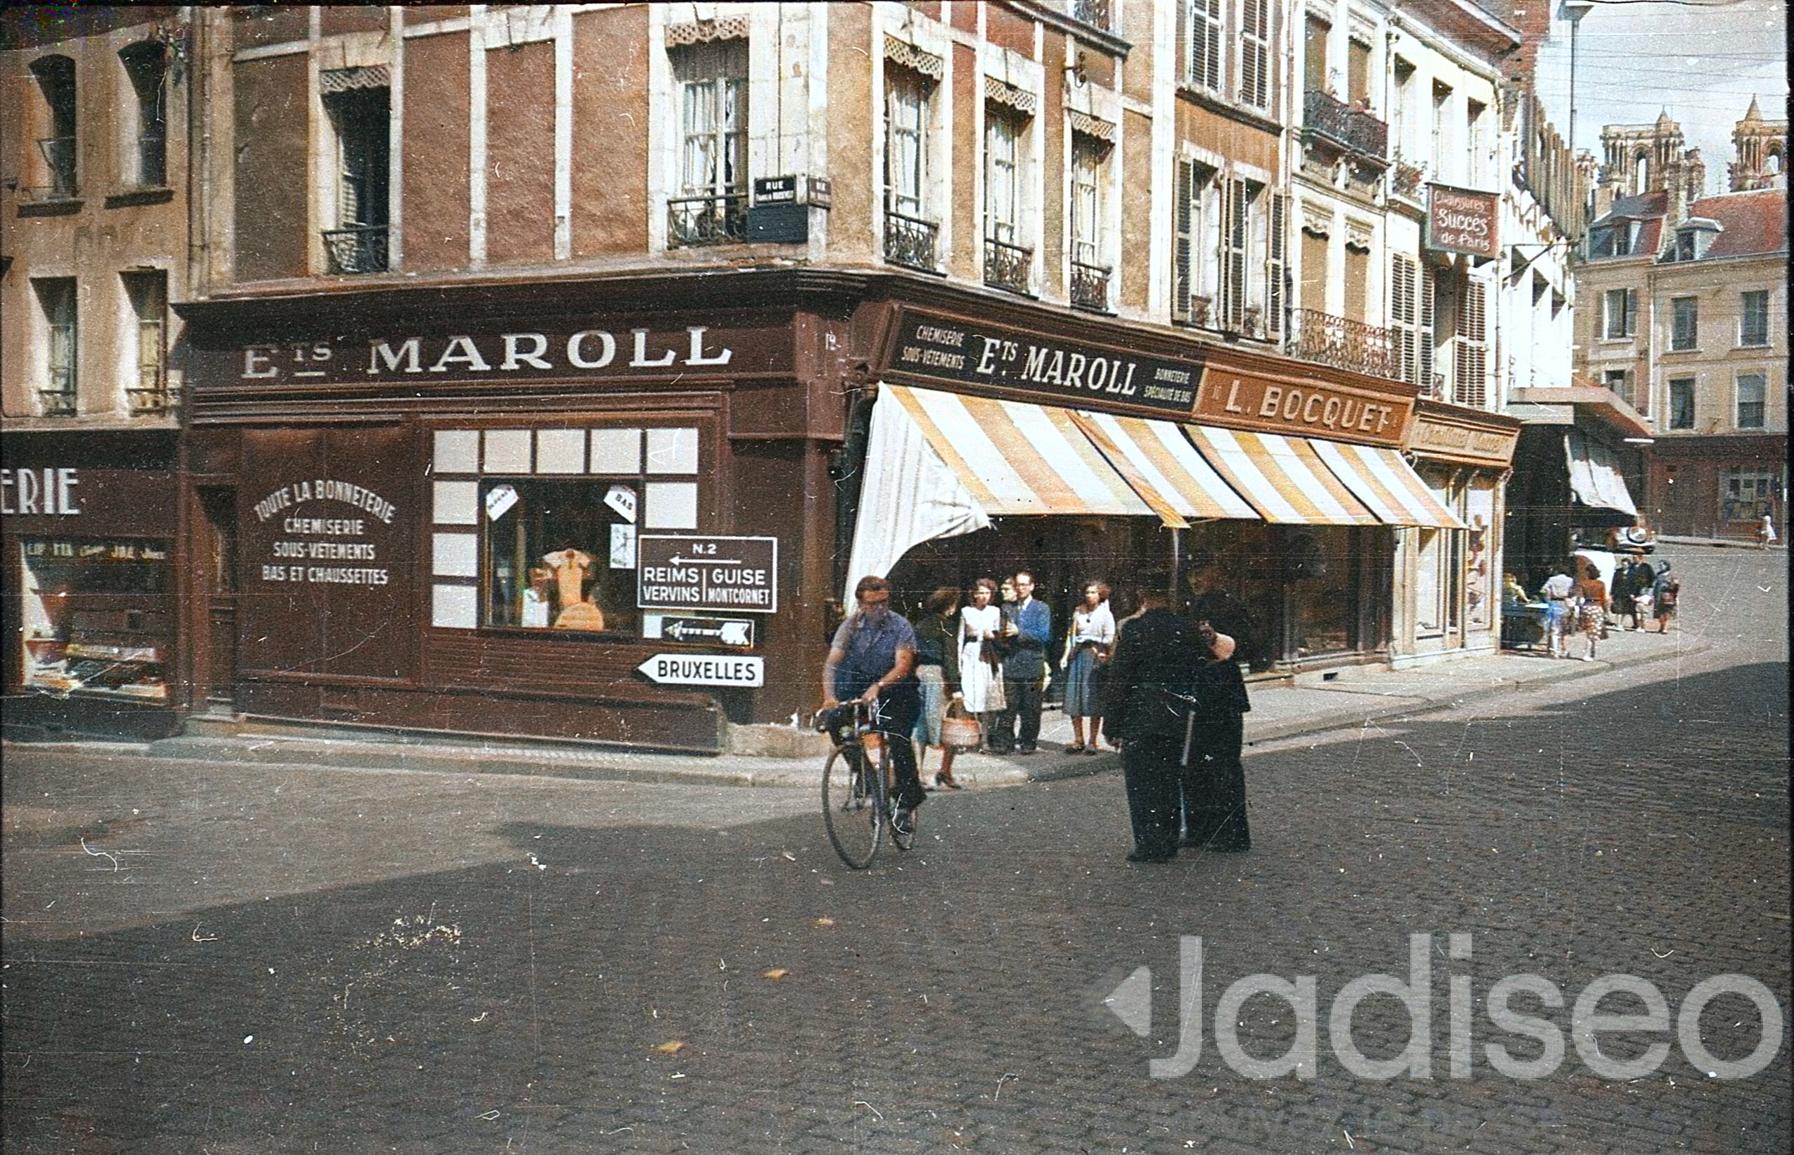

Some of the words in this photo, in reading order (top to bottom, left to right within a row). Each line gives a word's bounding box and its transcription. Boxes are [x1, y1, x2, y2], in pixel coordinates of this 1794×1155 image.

[766, 181, 784, 190] RUE
[1441, 231, 1455, 244] de
[1457, 232, 1490, 251] Paris
[916, 325, 965, 347] CHEMISERIE
[367, 326, 732, 375] MAROLL
[1021, 346, 1137, 395] MAROLL
[1154, 368, 1191, 384] BONNETERIE
[1225, 379, 1250, 415] L.
[1259, 385, 1393, 433] BOCQUET
[1, 467, 80, 514] ERIE
[254, 487, 291, 521] TOUTE
[293, 481, 312, 502] LA
[315, 480, 396, 524] BONNETERIE
[615, 493, 633, 511] BAS
[284, 518, 364, 535] CHEMISERIE
[692, 543, 717, 554] N.2
[262, 565, 286, 581] BAS
[290, 566, 304, 581] ET
[308, 567, 388, 584] CHAUSSETTES
[643, 567, 699, 582] REIMS
[712, 569, 766, 585] GUISE
[643, 586, 700, 602] VERVINS
[707, 588, 770, 605] MONTCORNET
[657, 660, 756, 681] BRUXELLES
